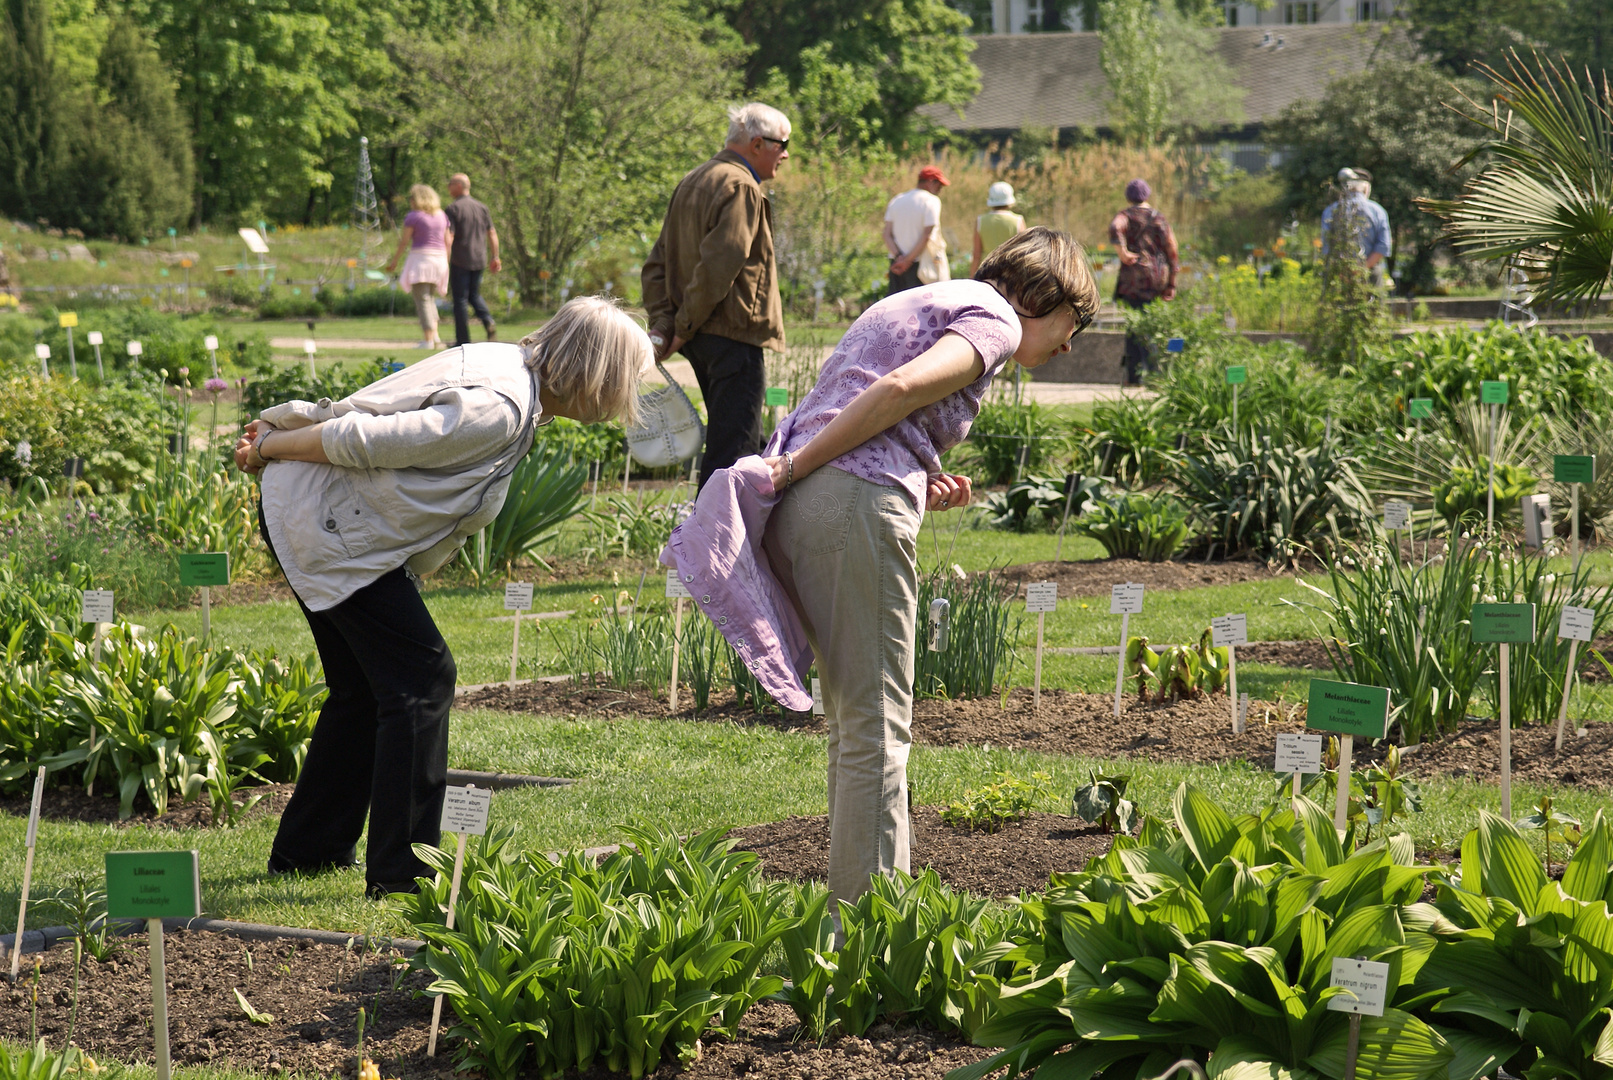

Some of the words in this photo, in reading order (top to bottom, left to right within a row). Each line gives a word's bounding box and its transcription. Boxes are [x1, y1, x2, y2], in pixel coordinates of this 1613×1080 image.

[1324, 692, 1371, 705] Melanthiaceae
[1337, 707, 1356, 716] Liliales
[1328, 715, 1363, 727] Monokotyle
[133, 867, 165, 876] Liliaceae
[140, 884, 161, 893] Liliales
[131, 896, 170, 907] Monokotyle
[1335, 977, 1358, 987] Veratrum
[1360, 981, 1378, 991] nigrum
